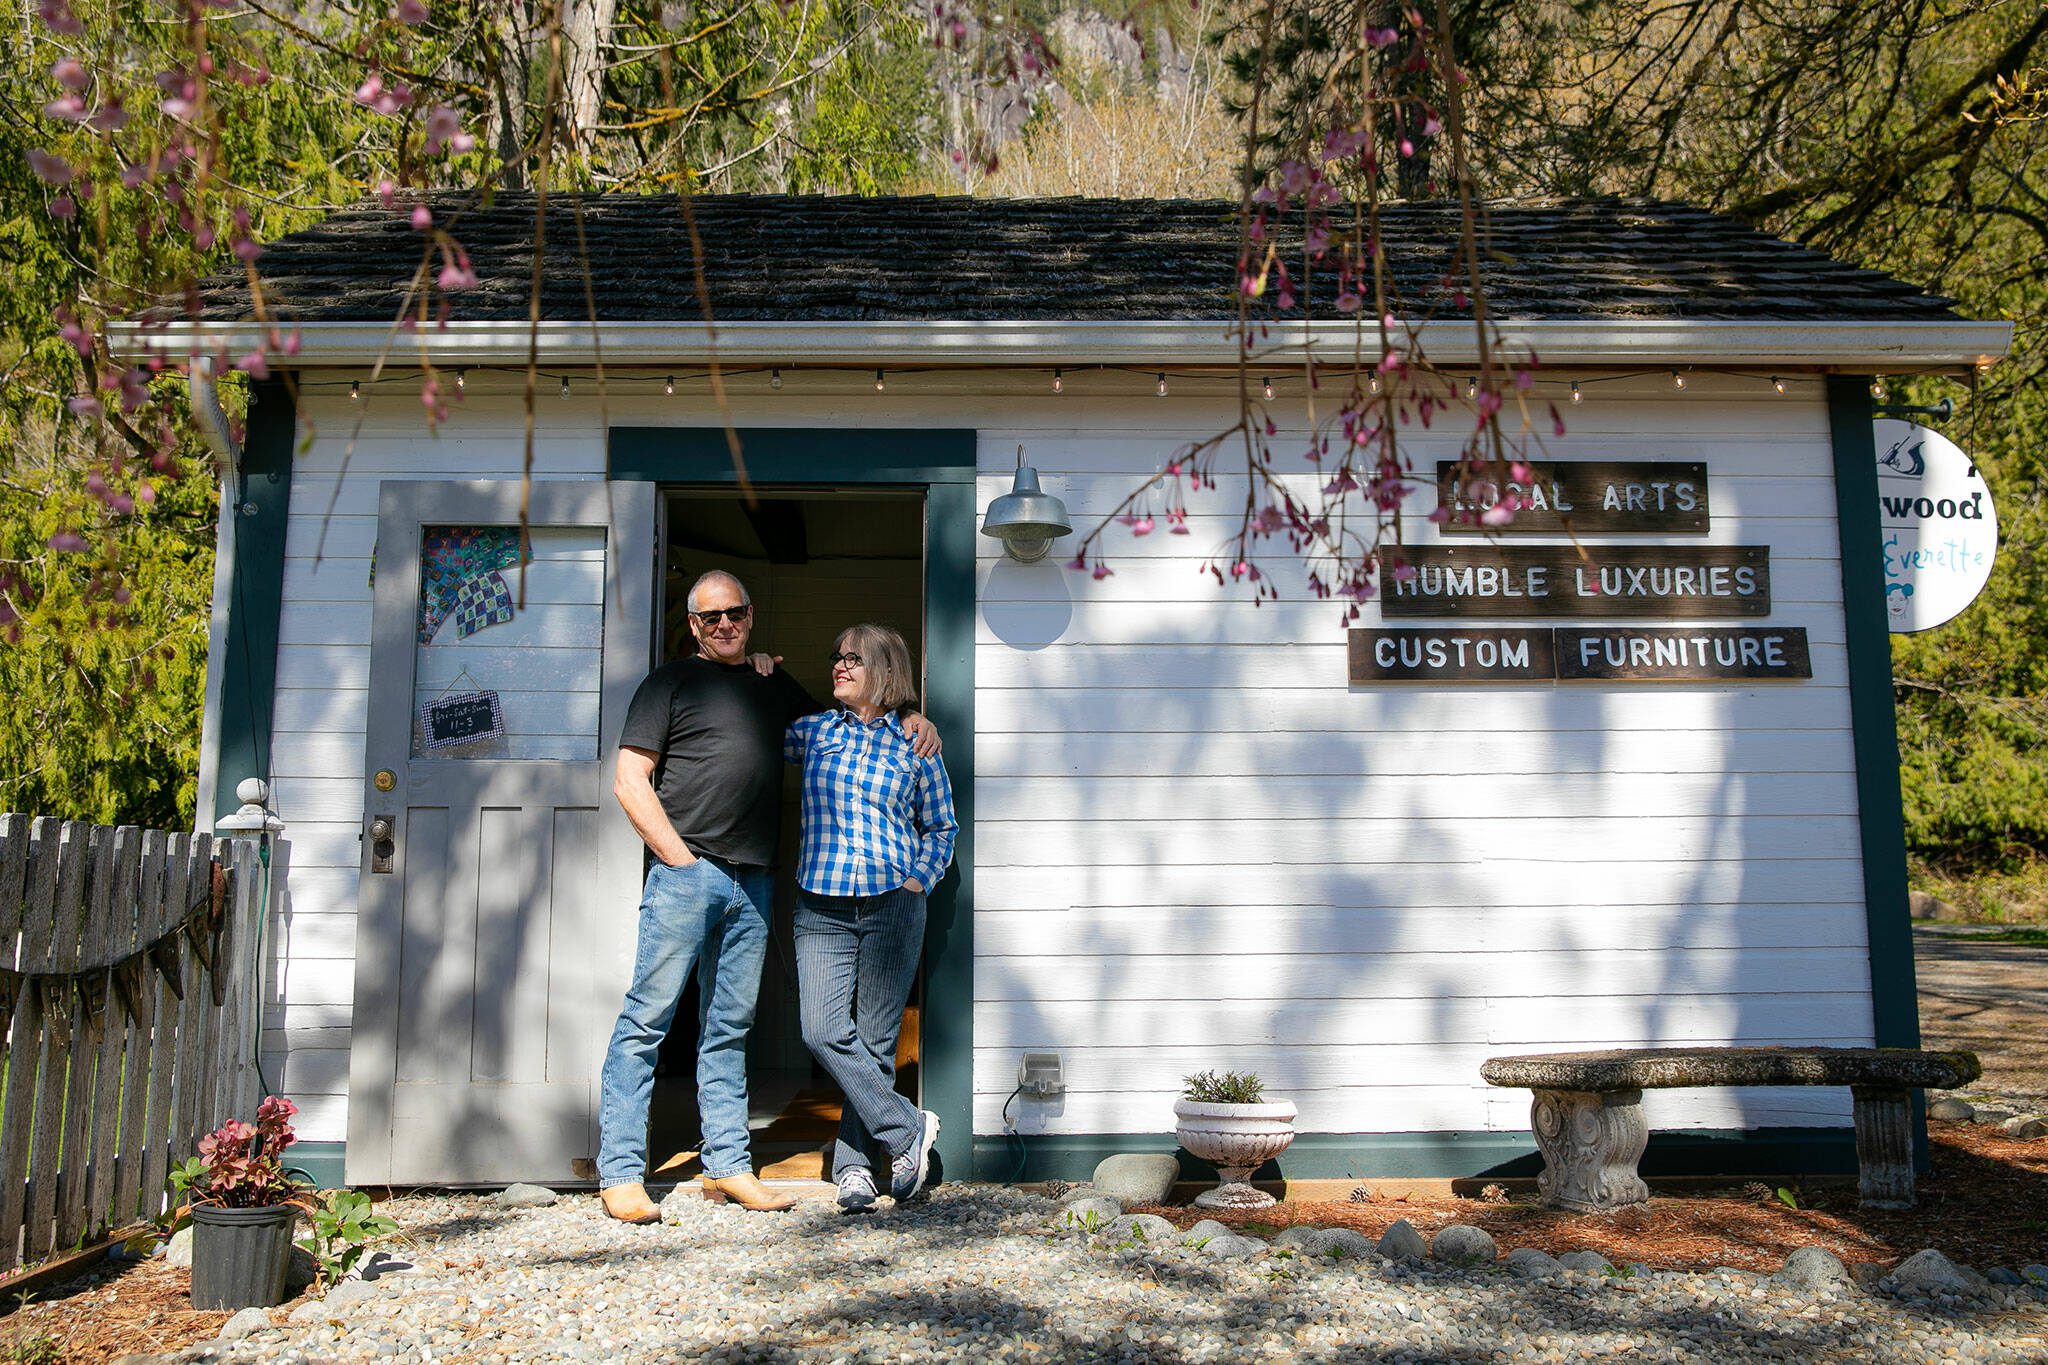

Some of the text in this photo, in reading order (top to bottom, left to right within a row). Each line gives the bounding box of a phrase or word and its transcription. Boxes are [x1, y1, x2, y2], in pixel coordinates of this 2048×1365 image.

[1603, 482, 1697, 512] ARTS
[1883, 534, 1984, 577] Everette
[1396, 566, 1757, 597] HUMBLE LUXURIES
[1374, 636, 1788, 668] CUSTOM FURNITURE
